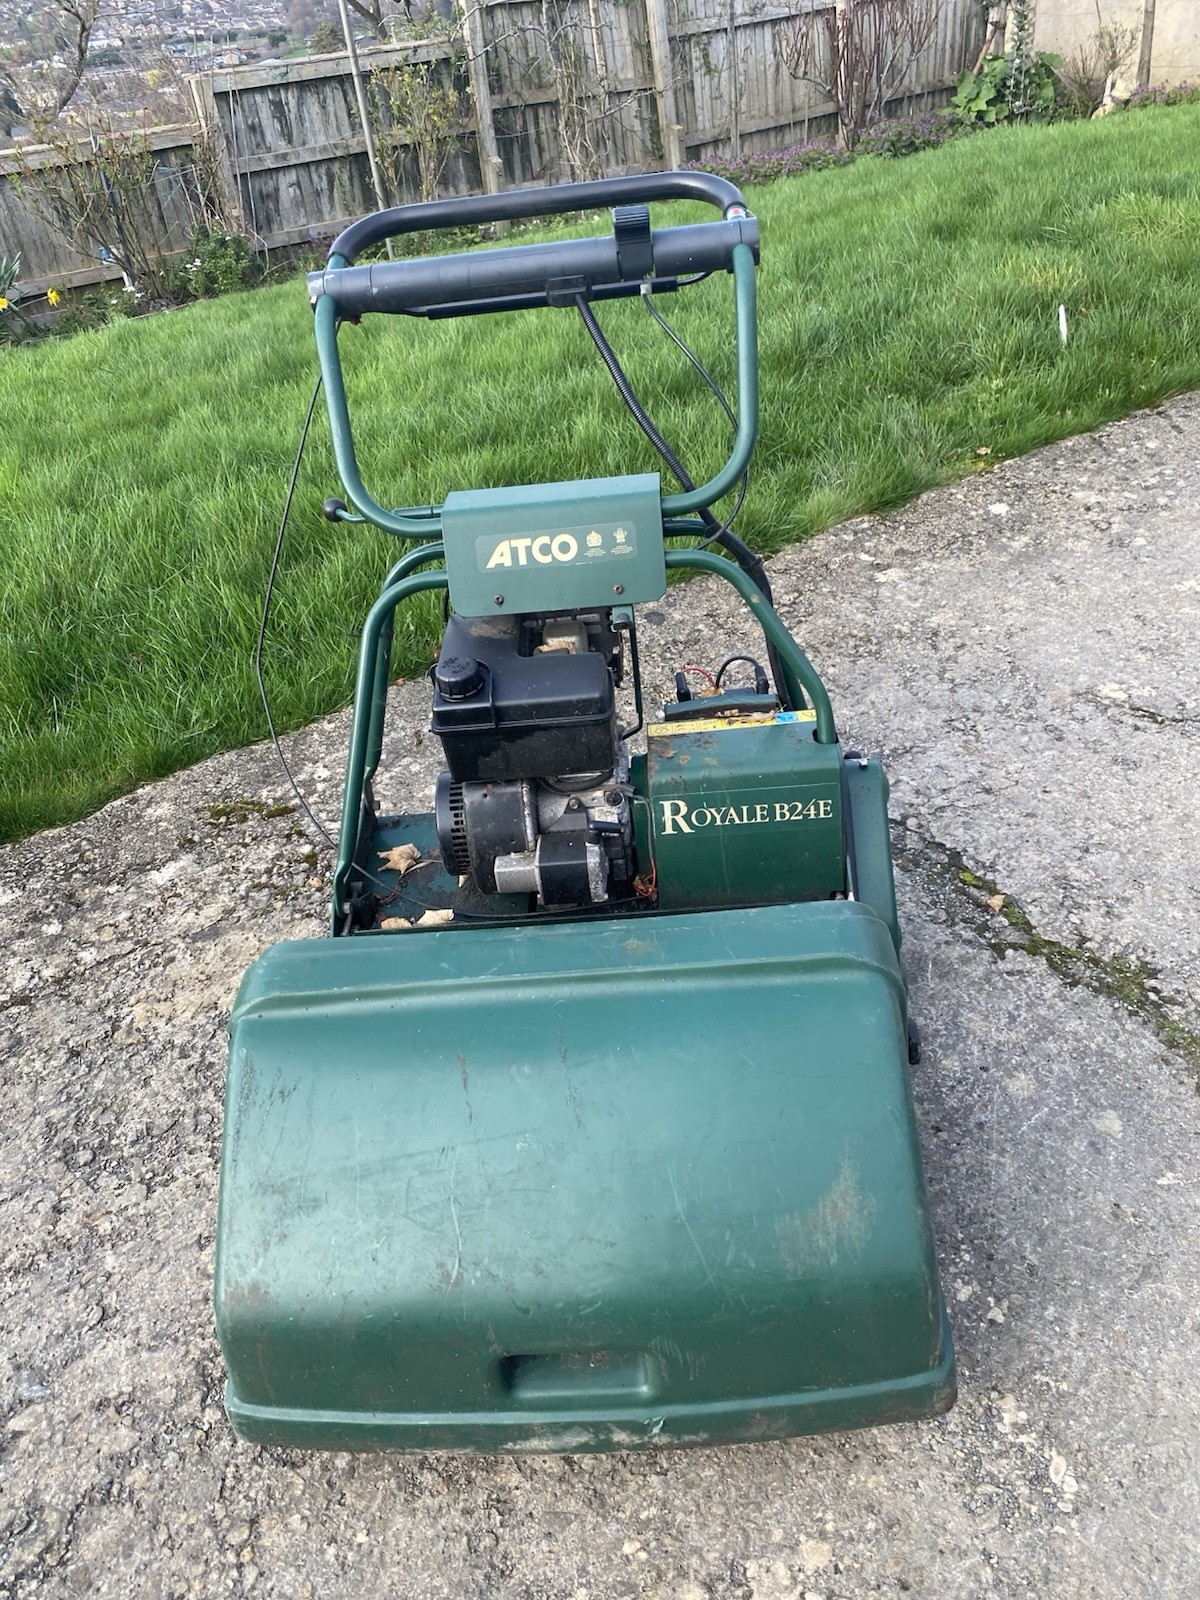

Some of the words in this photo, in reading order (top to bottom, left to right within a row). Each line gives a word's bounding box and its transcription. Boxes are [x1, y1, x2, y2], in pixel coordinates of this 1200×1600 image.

[486, 533, 578, 569] ATCO
[659, 800, 770, 835] ROYALE
[774, 798, 834, 822] B24E
